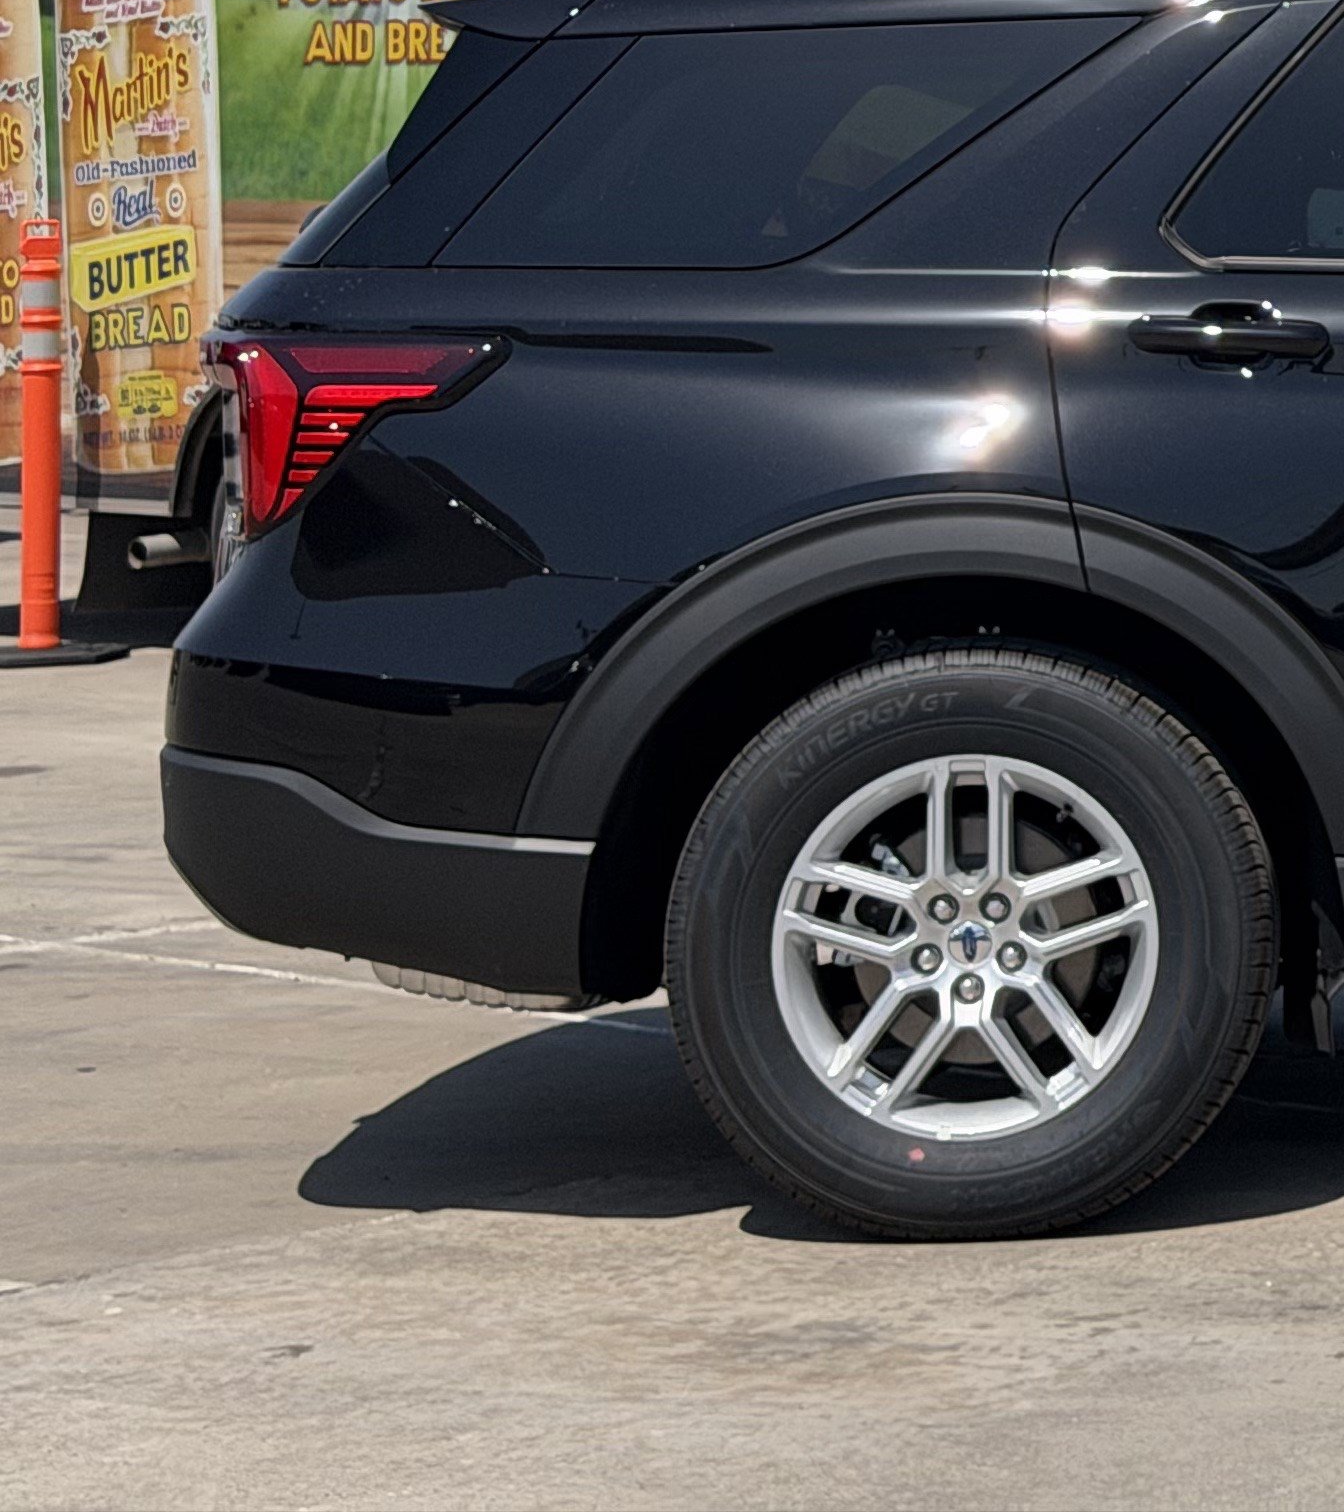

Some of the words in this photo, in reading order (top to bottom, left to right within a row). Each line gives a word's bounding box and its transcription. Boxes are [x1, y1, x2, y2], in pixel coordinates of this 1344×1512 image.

[304, 20, 375, 65] AND
[385, 19, 448, 65] BRE
[76, 41, 192, 155] Martin's
[75, 149, 197, 184] Old-Fashioned
[112, 179, 162, 230] Real
[88, 238, 190, 301] BUTTER
[89, 302, 192, 352] BREAD
